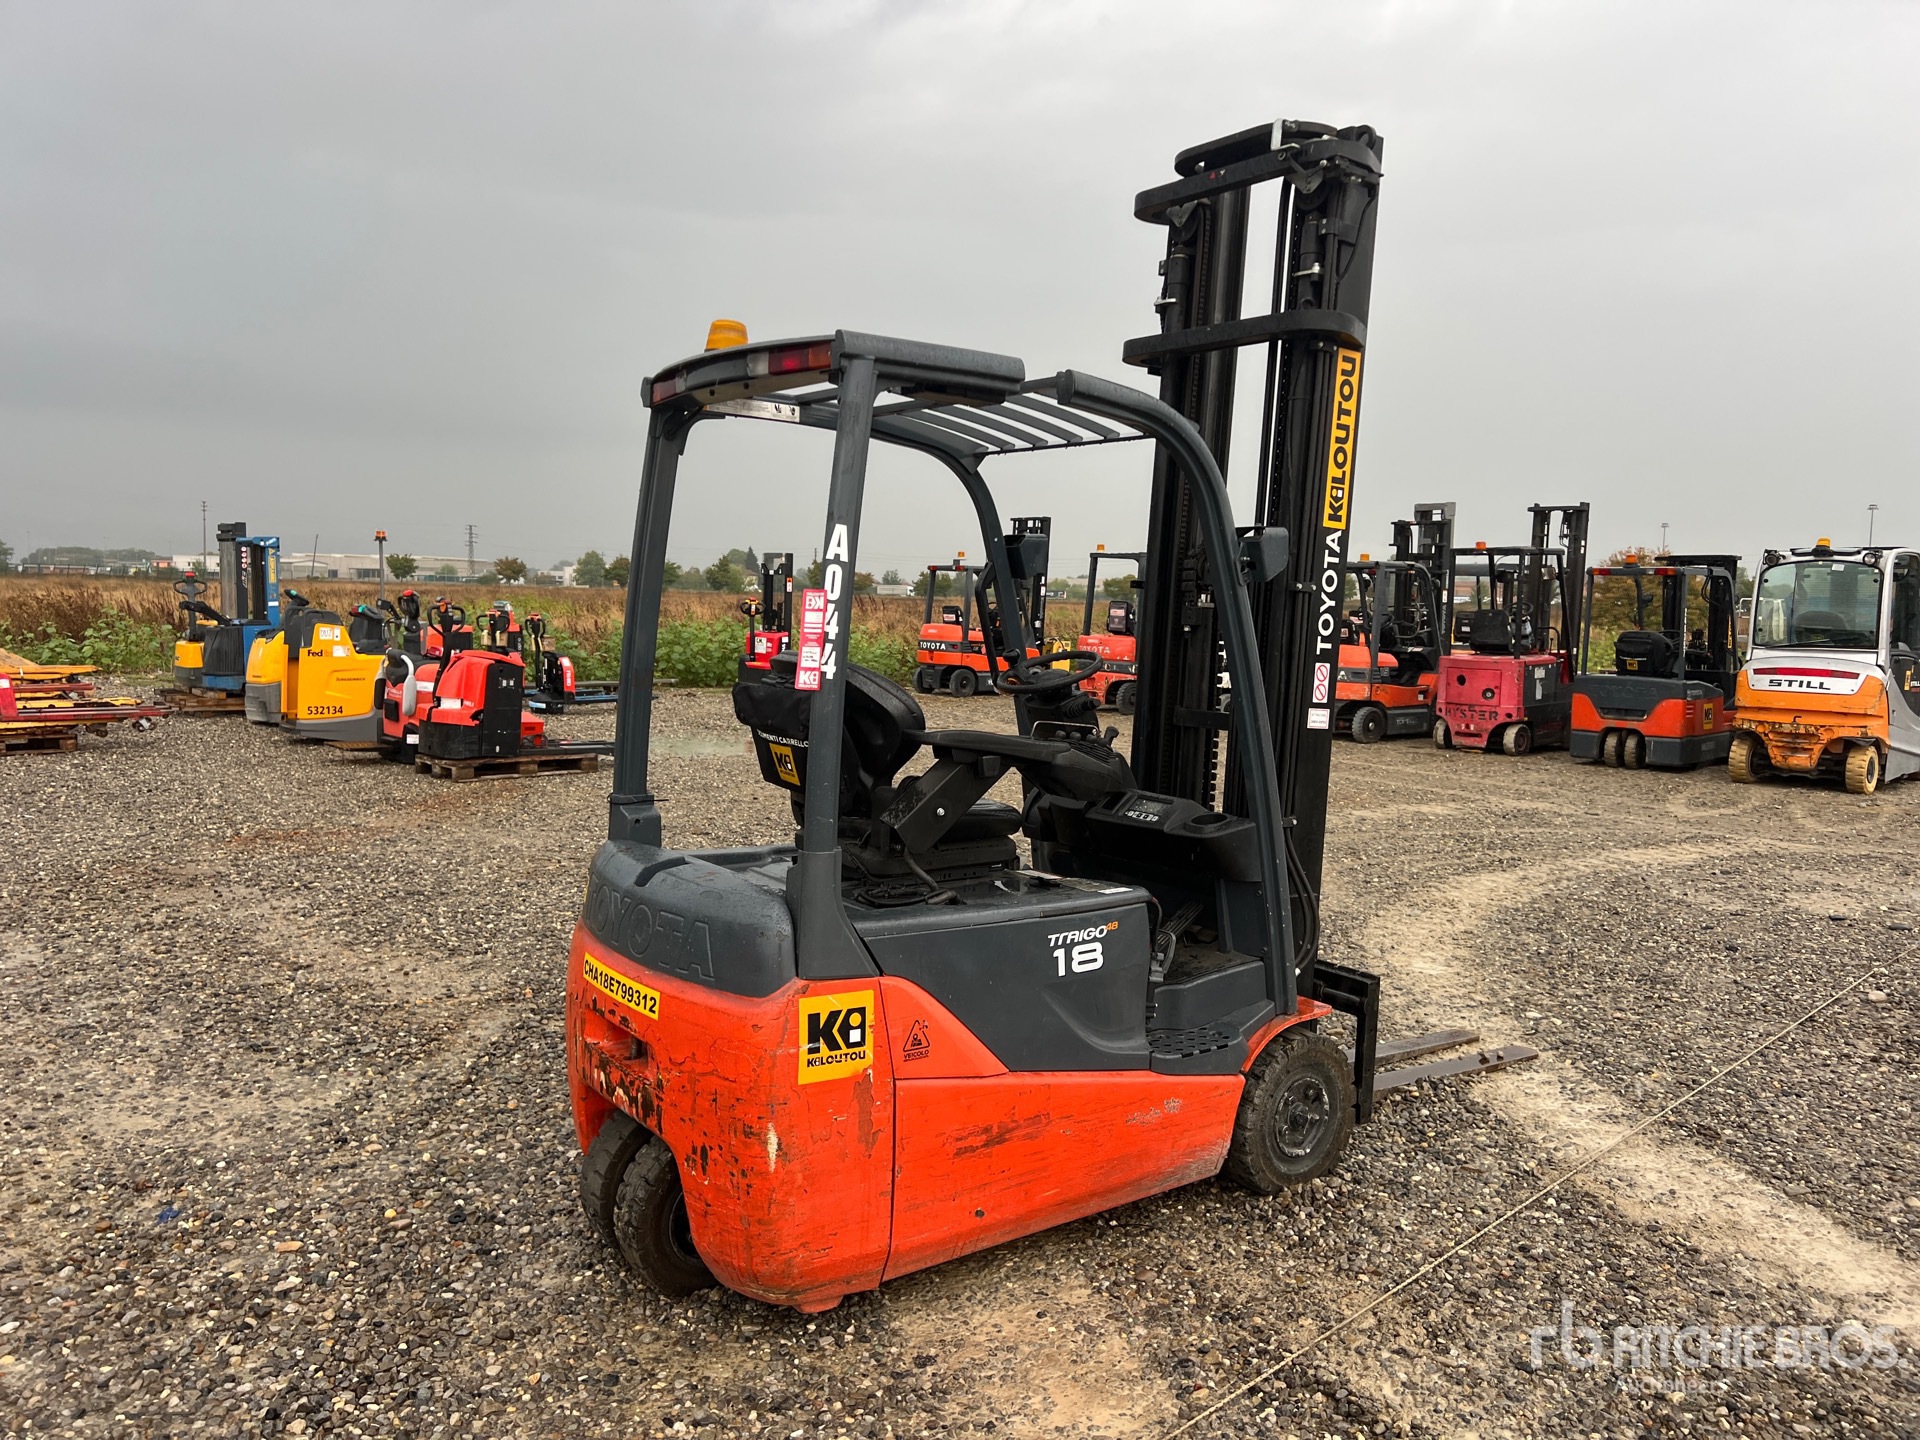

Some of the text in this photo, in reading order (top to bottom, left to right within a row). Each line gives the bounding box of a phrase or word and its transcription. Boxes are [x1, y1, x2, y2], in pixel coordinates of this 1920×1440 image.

[1316, 530, 1342, 655] TOYOTA
[920, 641, 946, 650] TOYOTA
[1080, 645, 1111, 654] TOYOTA
[1768, 679, 1831, 691] STILL
[307, 706, 343, 715] 532134
[1445, 705, 1499, 721] HYSTER
[587, 874, 715, 981] TOYOTA
[1105, 921, 1119, 931] 48
[1053, 941, 1104, 977] 18
[584, 959, 658, 1015] CHA18E799312
[903, 1049, 930, 1061] VEICOLO
